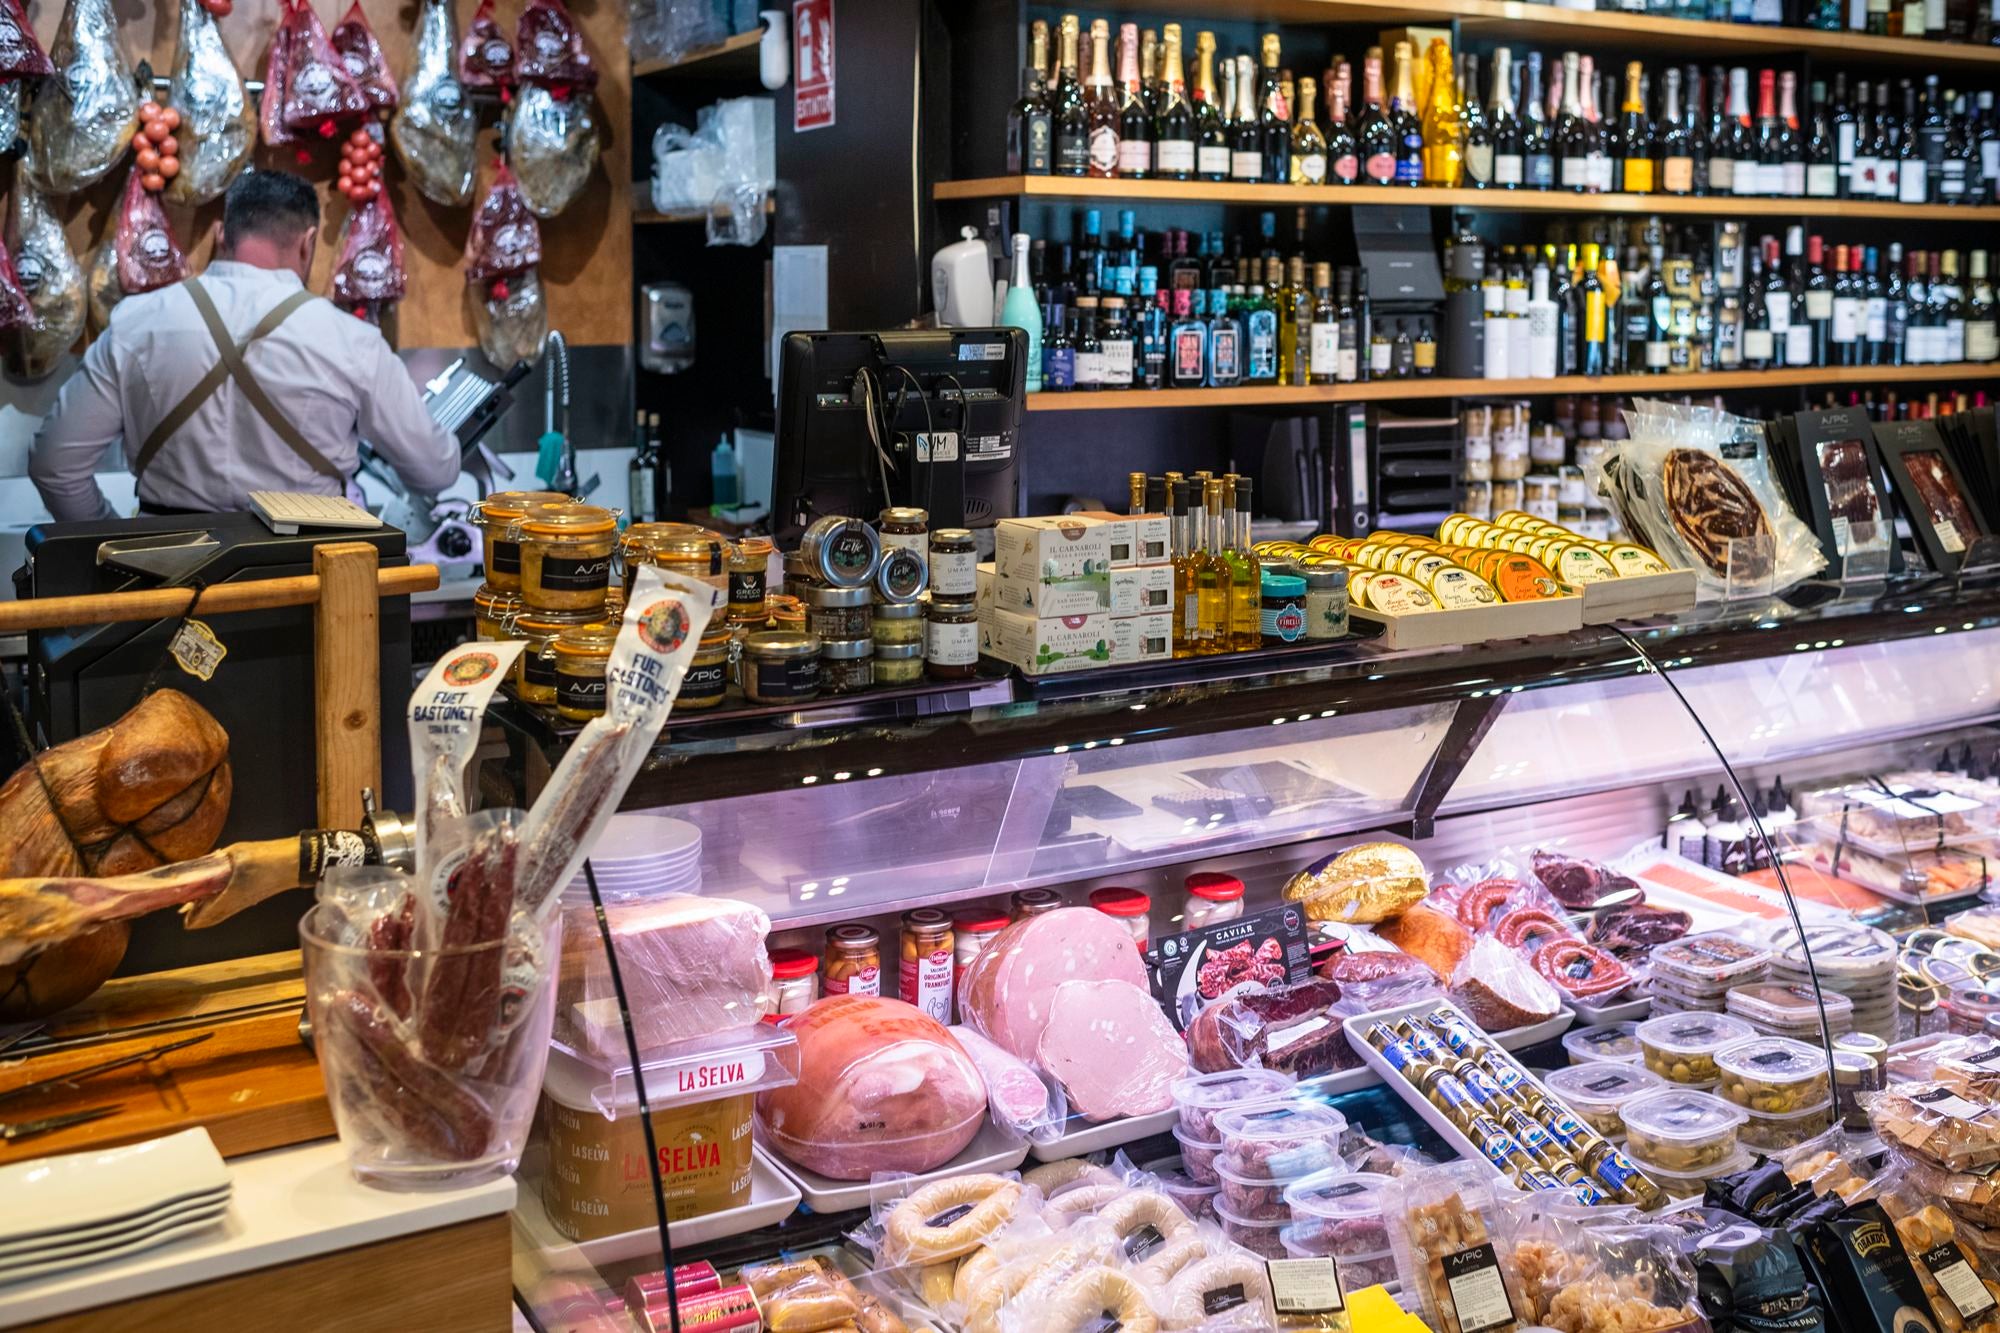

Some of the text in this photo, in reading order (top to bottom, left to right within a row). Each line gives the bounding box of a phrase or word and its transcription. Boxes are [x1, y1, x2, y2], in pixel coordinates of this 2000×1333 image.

[1059, 543, 1102, 553] CARNAROLI
[1057, 631, 1100, 641] CARNAROLI
[633, 653, 663, 678] FUET
[433, 691, 469, 704] FUET
[413, 705, 478, 721] BASTONET
[1216, 925, 1253, 941] CAVIAR
[924, 972, 946, 981] ORIGINAL
[679, 1062, 745, 1092] LA SELVA
[732, 1127, 741, 1141] LA
[572, 1143, 610, 1161] LA SELVA
[623, 1142, 721, 1181] LA SELVA
[731, 1181, 740, 1194] LA
[571, 1197, 610, 1216] LA SELVA
[1857, 1233, 1888, 1253] OBANDO
[1452, 1249, 1483, 1266] ASPIC
[1788, 1319, 1801, 1328] DE
[1800, 1316, 1818, 1327] PAN
